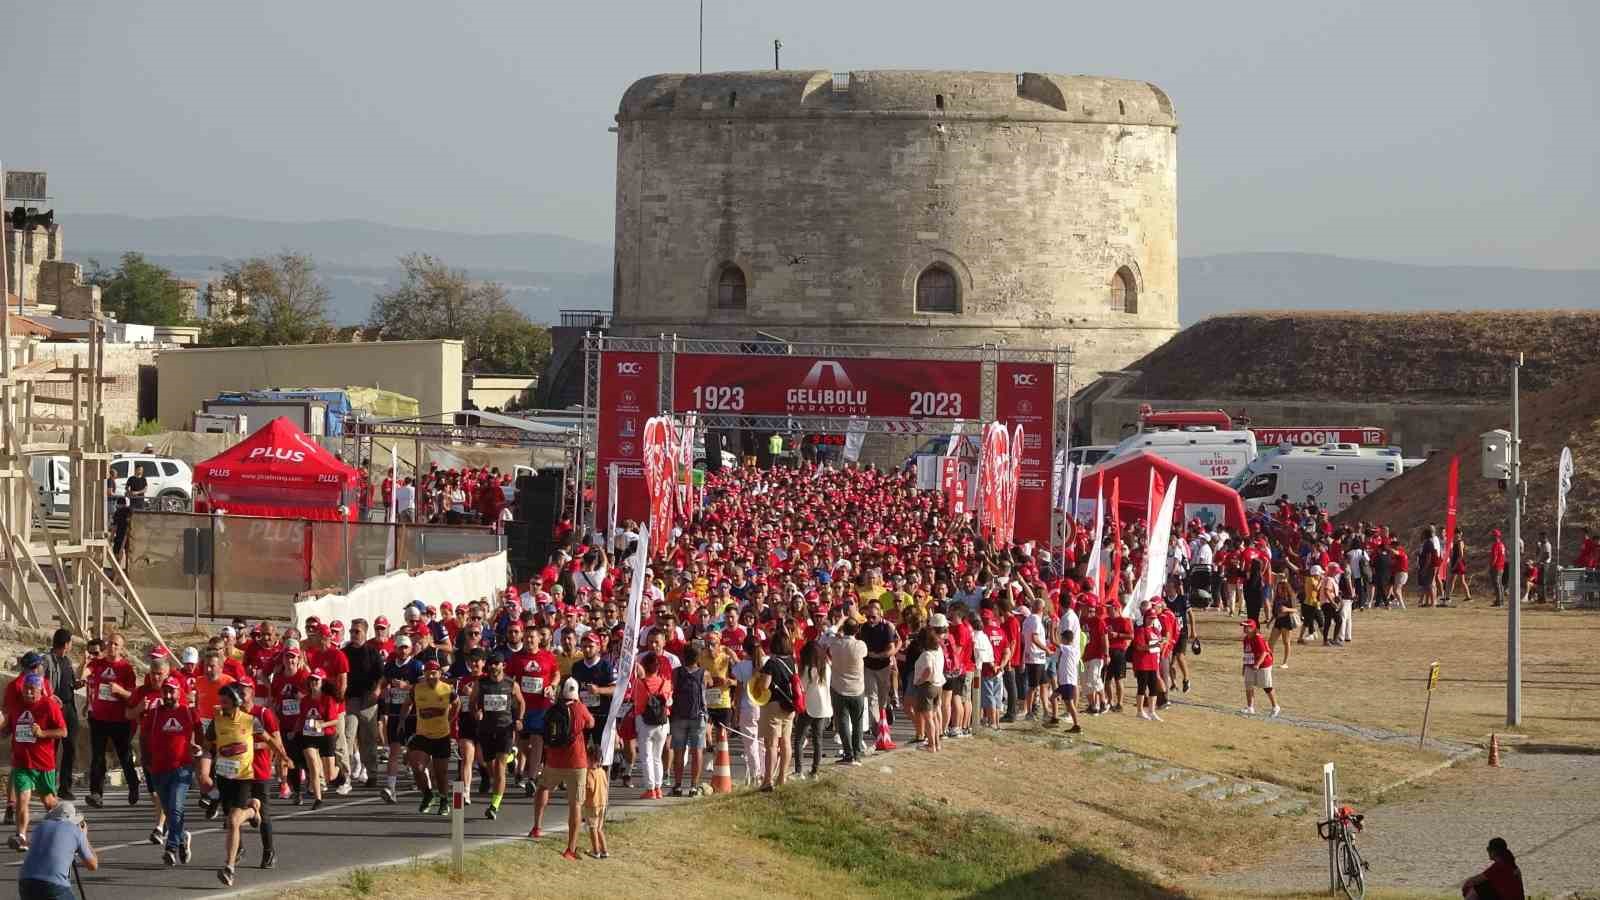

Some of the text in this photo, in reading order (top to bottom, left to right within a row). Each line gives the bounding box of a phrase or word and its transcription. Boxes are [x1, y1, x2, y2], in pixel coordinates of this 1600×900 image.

[692, 385, 744, 410] 1923
[909, 391, 961, 416] 2023
[786, 404, 866, 414] MARATONU
[1263, 433, 1273, 444] 17
[1300, 431, 1340, 445] OGM
[249, 447, 305, 463] PLUS
[209, 468, 231, 478] PLUS
[1211, 465, 1229, 476] 112
[318, 473, 339, 484] PLUS
[1339, 479, 1369, 495] net
